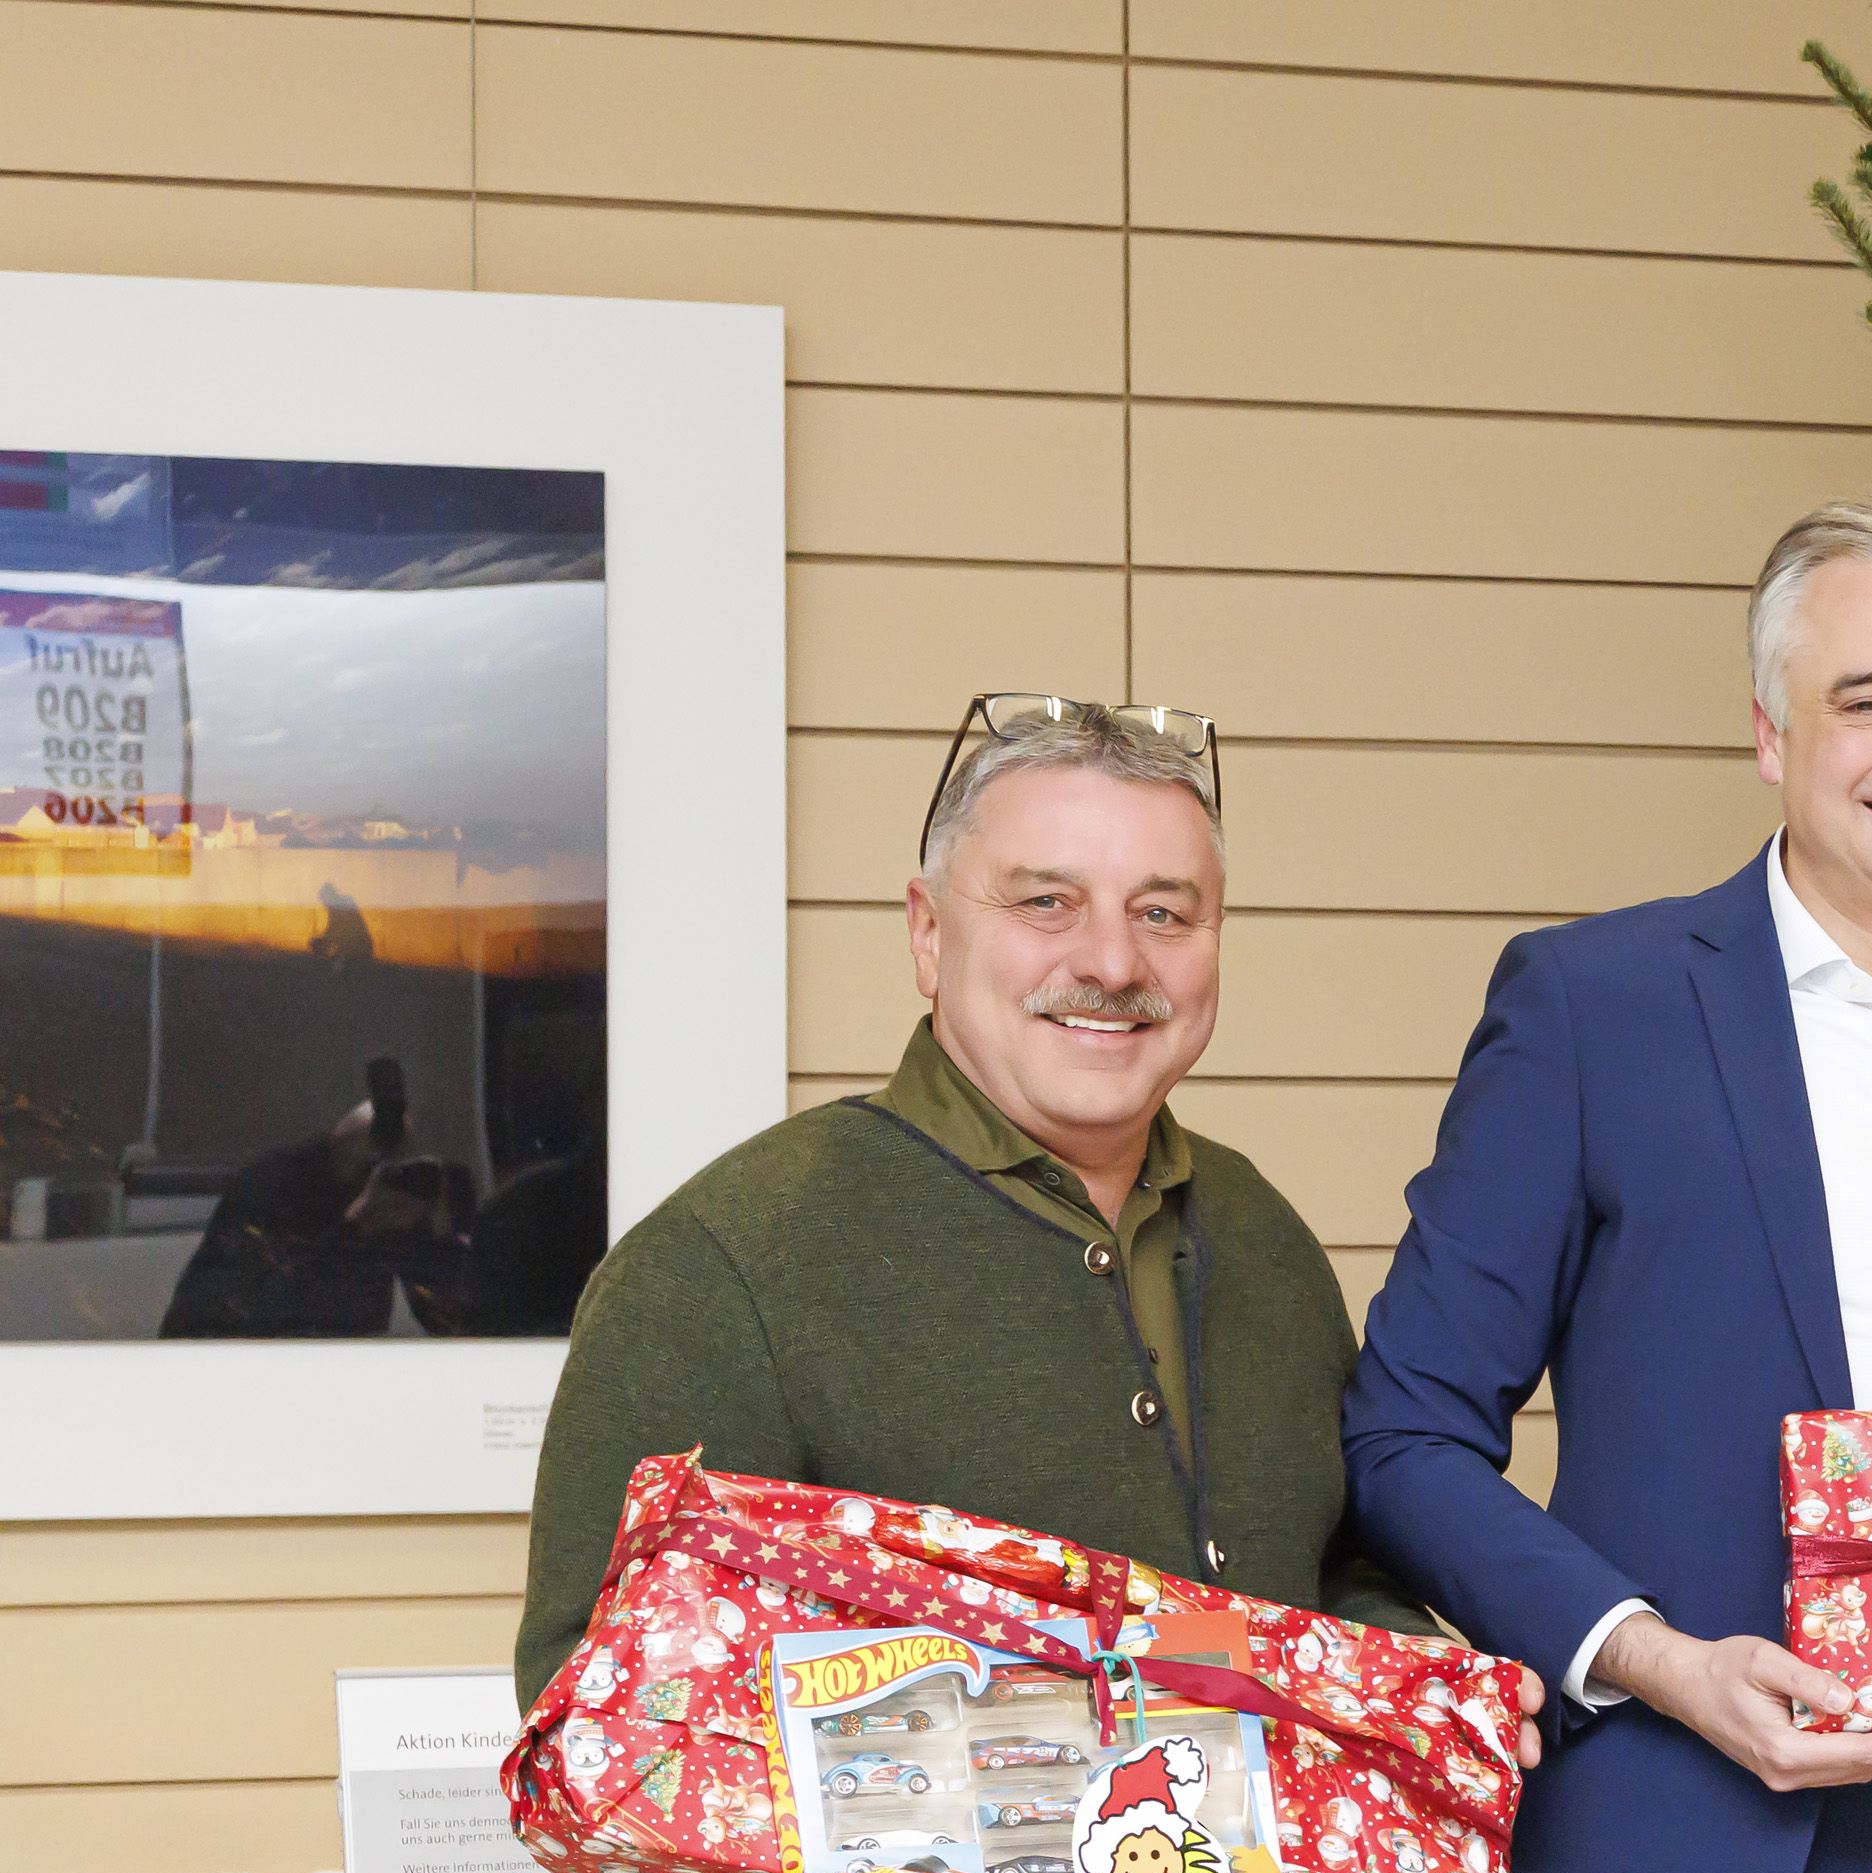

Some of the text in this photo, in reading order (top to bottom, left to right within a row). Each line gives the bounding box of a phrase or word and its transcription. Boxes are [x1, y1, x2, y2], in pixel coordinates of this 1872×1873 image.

[396, 1731, 513, 1750] Aktion Kinde
[398, 1784, 503, 1801] Schade, leider sin
[400, 1819, 420, 1829] Fall
[423, 1818, 441, 1829] Sie
[444, 1818, 466, 1828] uns
[401, 1836, 422, 1845] uns
[426, 1833, 455, 1844] auch
[458, 1832, 493, 1846] gerne
[453, 1859, 539, 1873] Informationen
